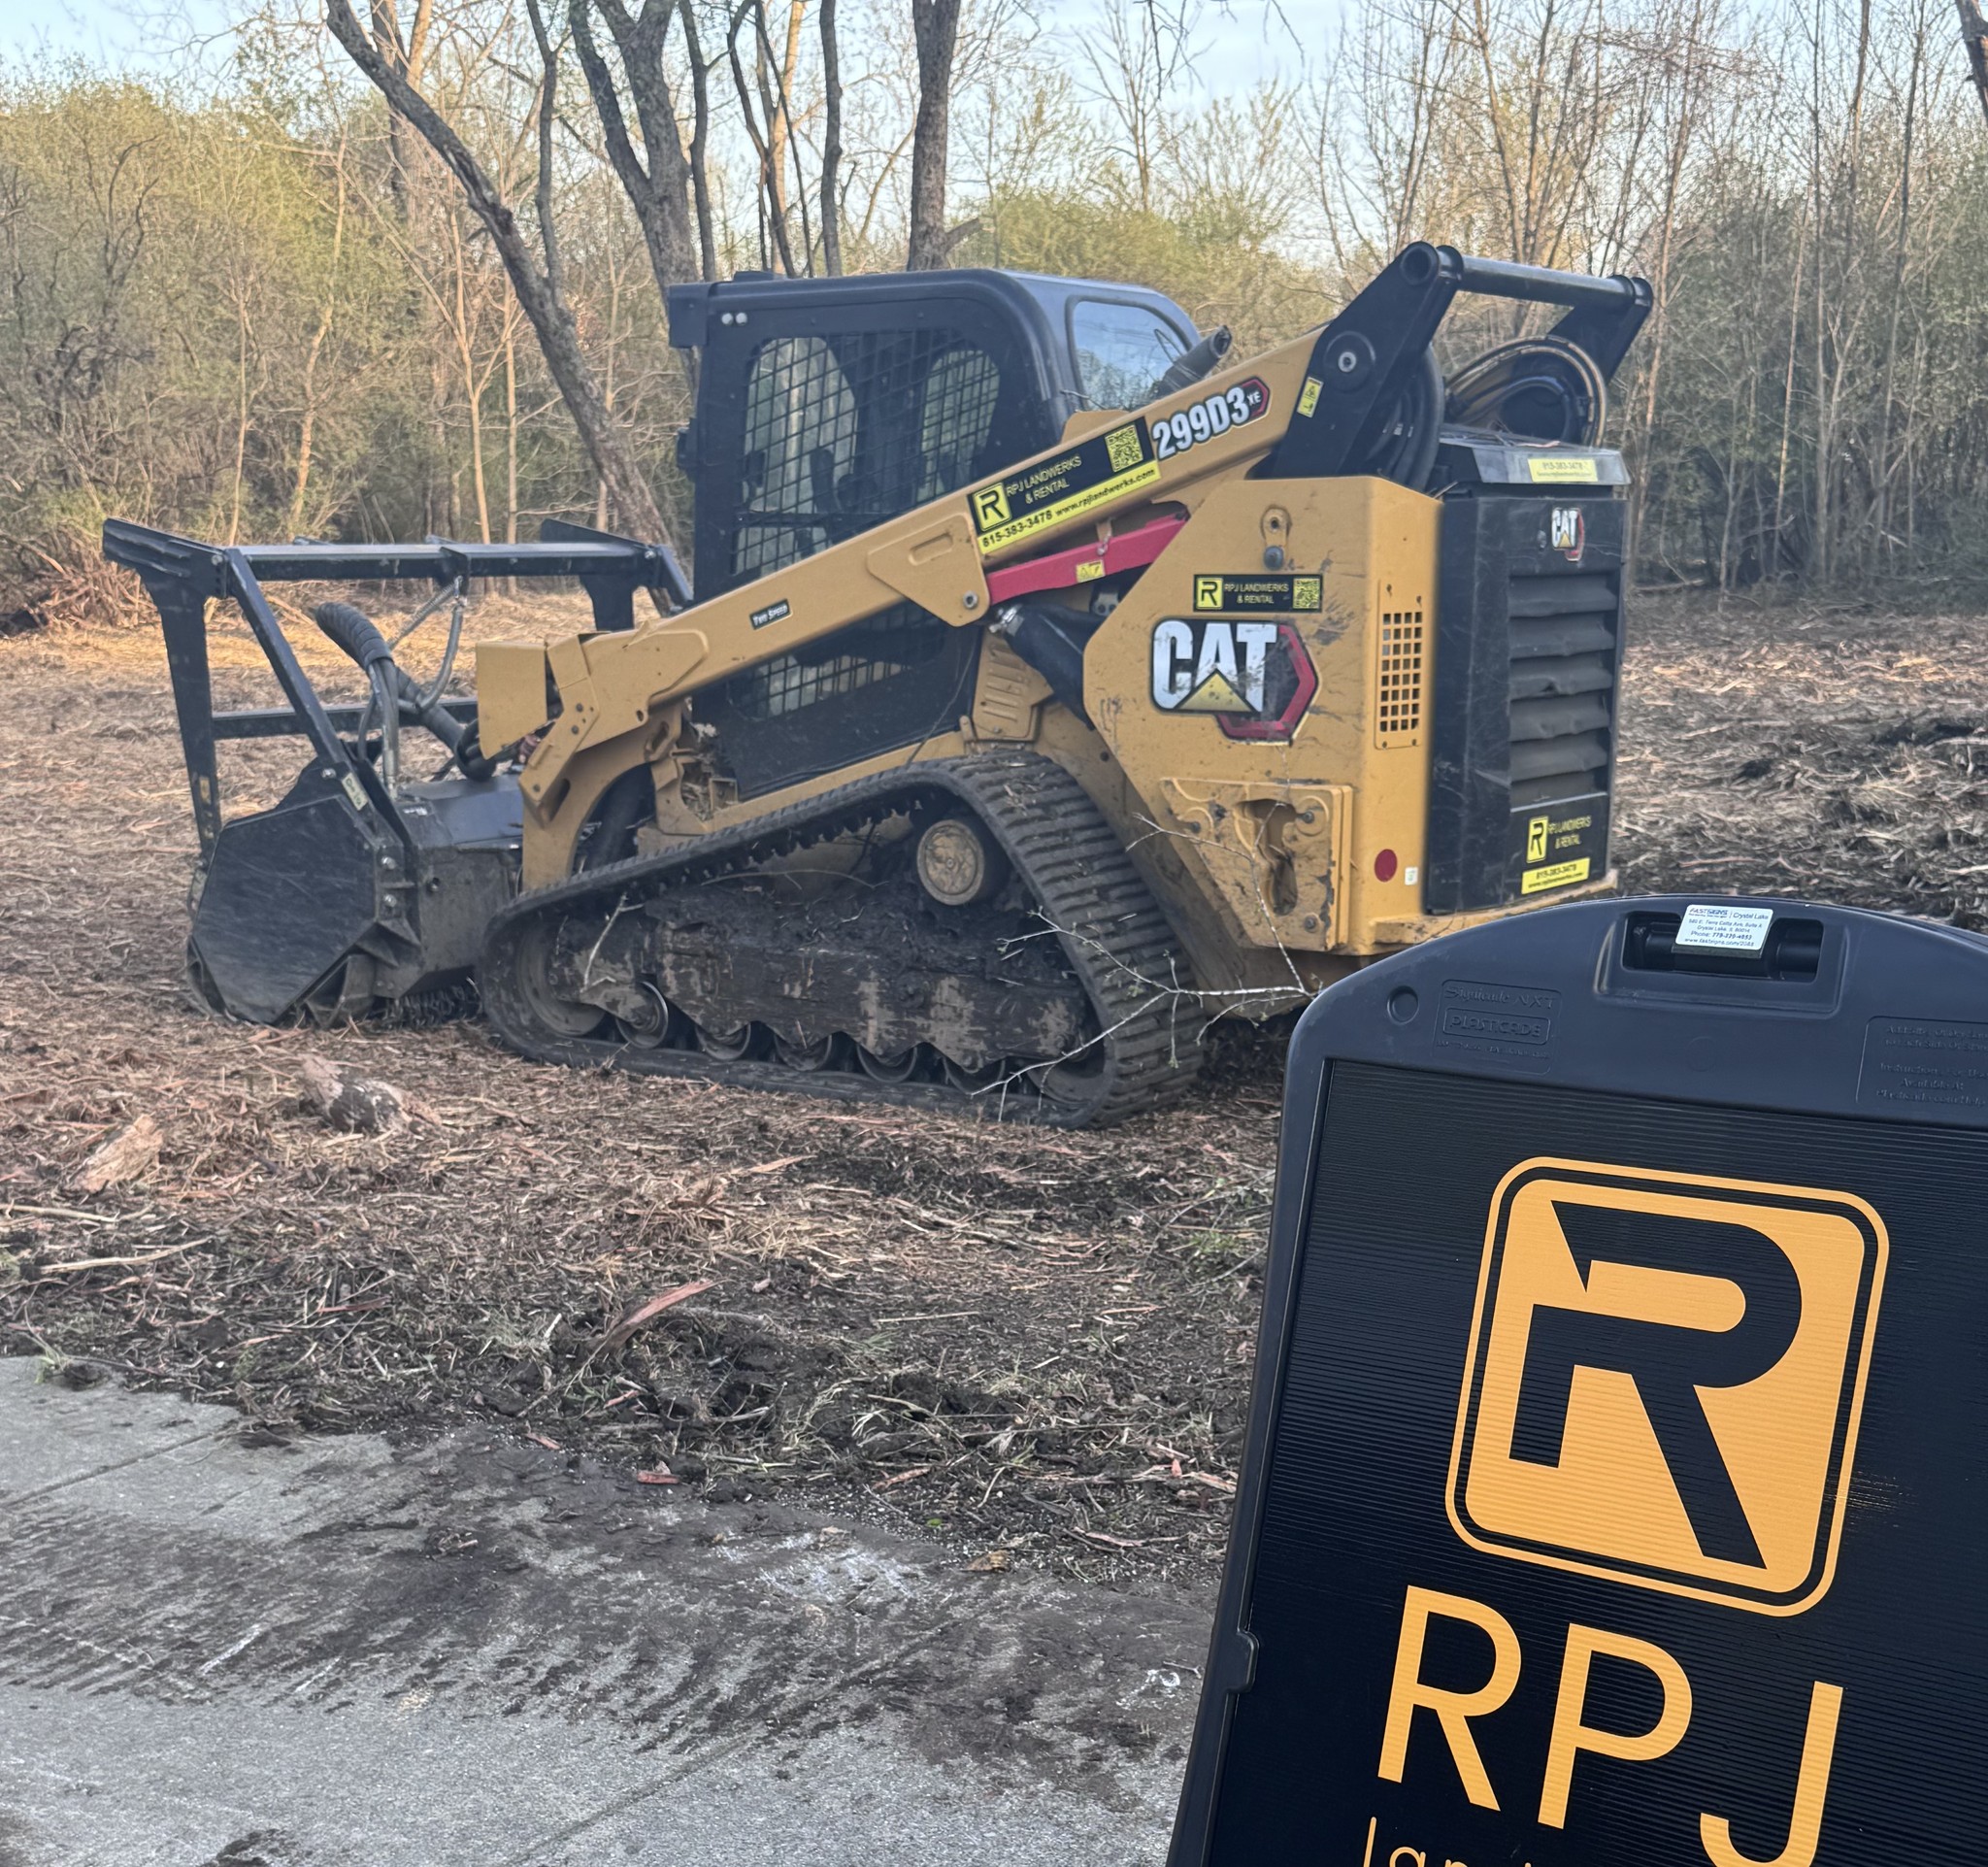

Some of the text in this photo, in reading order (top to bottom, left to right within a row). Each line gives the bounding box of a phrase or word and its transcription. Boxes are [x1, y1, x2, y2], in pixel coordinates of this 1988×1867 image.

[1152, 387, 1262, 459] 299D3 XE
[1007, 455, 1082, 496] RPJ LANDWERKS
[1025, 479, 1071, 504] & RENTAL
[979, 490, 1005, 520] R
[982, 510, 1052, 547] 815-383-3478
[1553, 509, 1578, 548] CAT
[1202, 582, 1217, 606] R
[1224, 583, 1289, 592] RPJ LANDWERKS
[1244, 594, 1275, 604] RENTAL
[1153, 619, 1277, 713] CAT
[1531, 822, 1544, 855] R
[1508, 1199, 1803, 1570] R
[1376, 1584, 1844, 1867] RPJ
